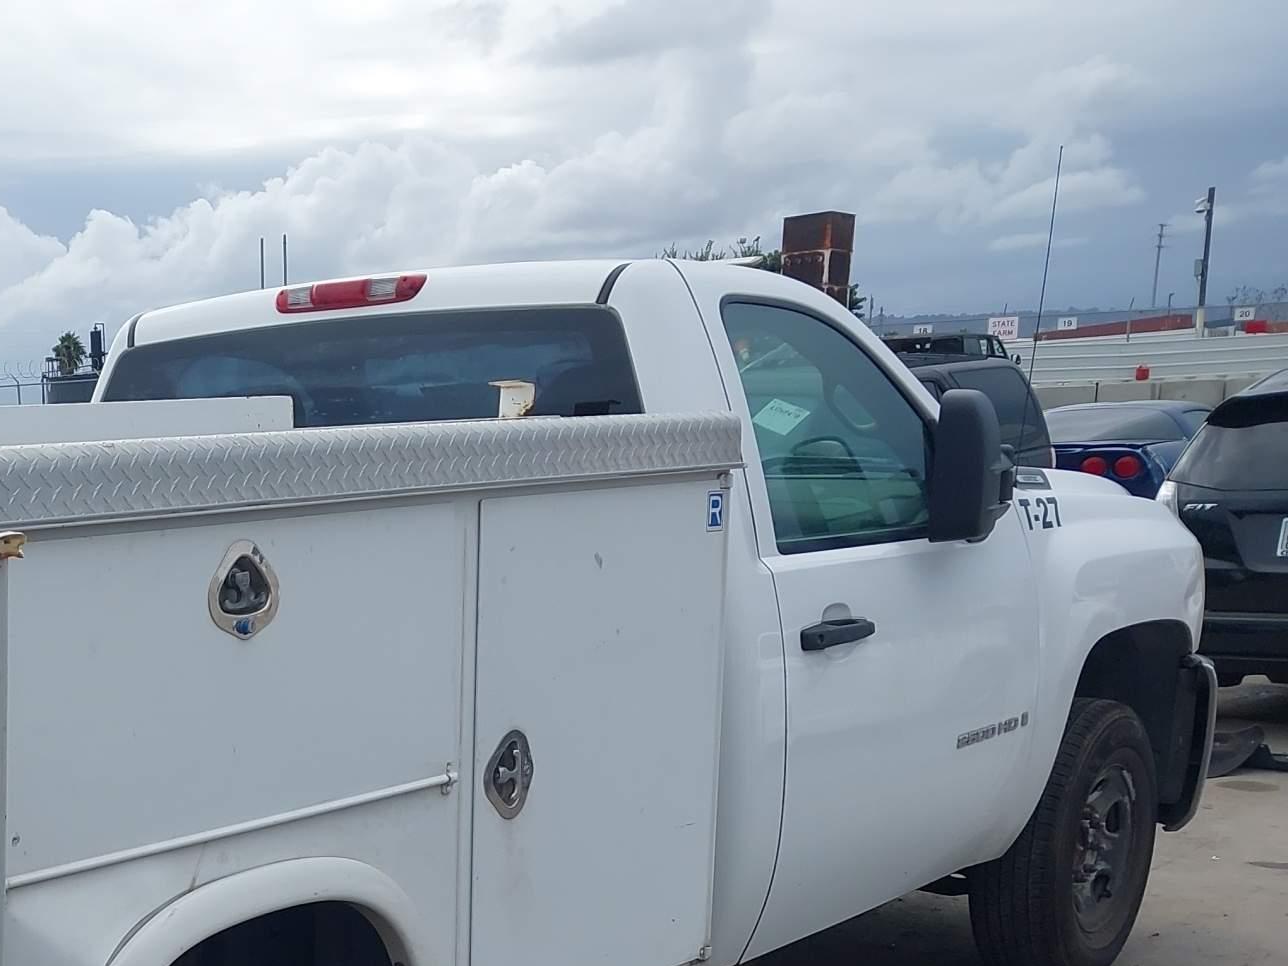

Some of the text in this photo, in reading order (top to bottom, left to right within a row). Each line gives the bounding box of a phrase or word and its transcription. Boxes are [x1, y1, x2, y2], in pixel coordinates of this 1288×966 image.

[1239, 310, 1250, 318] 20
[992, 319, 1015, 328] STATE
[1063, 319, 1073, 328] 19
[708, 495, 722, 525] R
[1183, 503, 1219, 512] FIT
[1018, 496, 1062, 531] T-27
